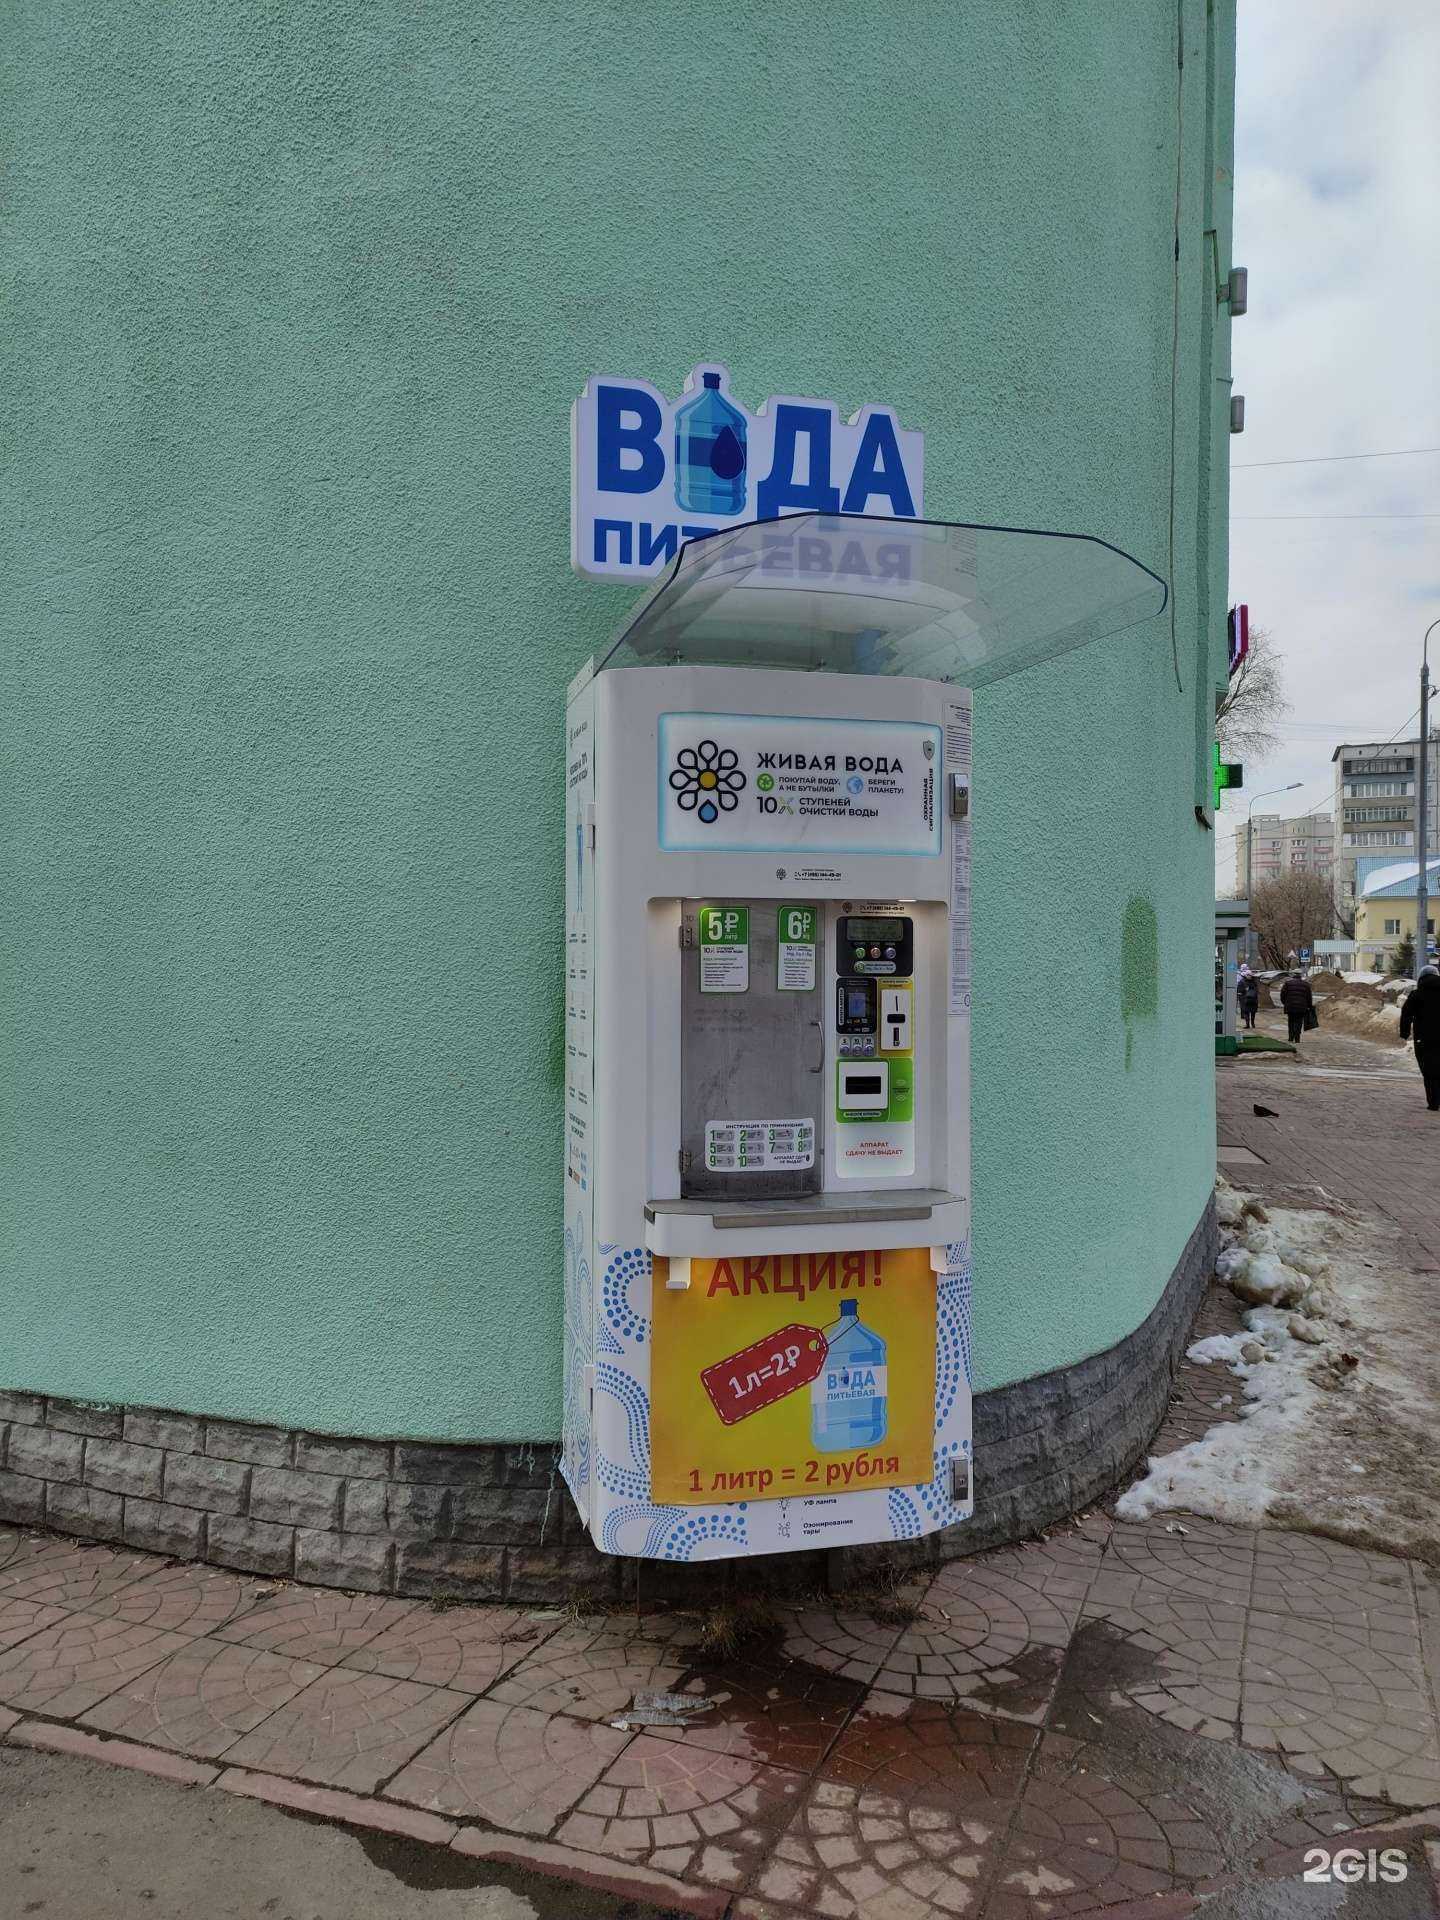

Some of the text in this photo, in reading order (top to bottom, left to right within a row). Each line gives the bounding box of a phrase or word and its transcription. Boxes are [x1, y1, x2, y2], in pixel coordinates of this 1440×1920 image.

[757, 752, 903, 775] ЖИВАЯ ВОДА
[779, 776, 816, 784] ПОКУПАЙ
[798, 785, 835, 793] БУТЫЛКИ
[799, 797, 851, 806] СТУПЕНЕЙ
[799, 807, 879, 817] ОЧИСТКИ ВОДЫ
[710, 1130, 715, 1141] 1
[740, 1130, 746, 1141] 2
[769, 1129, 775, 1140] 3
[798, 1128, 803, 1140] 4
[710, 1143, 716, 1154] 5
[740, 1142, 746, 1154] 6
[769, 1142, 775, 1153] 7
[798, 1141, 803, 1152] 8
[710, 1155, 716, 1167] 9
[738, 1155, 747, 1167] 10
[706, 1250, 883, 1301] АКЦИЯ!
[827, 1389, 876, 1401] ПИТЬЕВАЯ
[689, 1453, 900, 1493] 1 литр = 2 рубля
[803, 1519, 854, 1529] Озонирование
